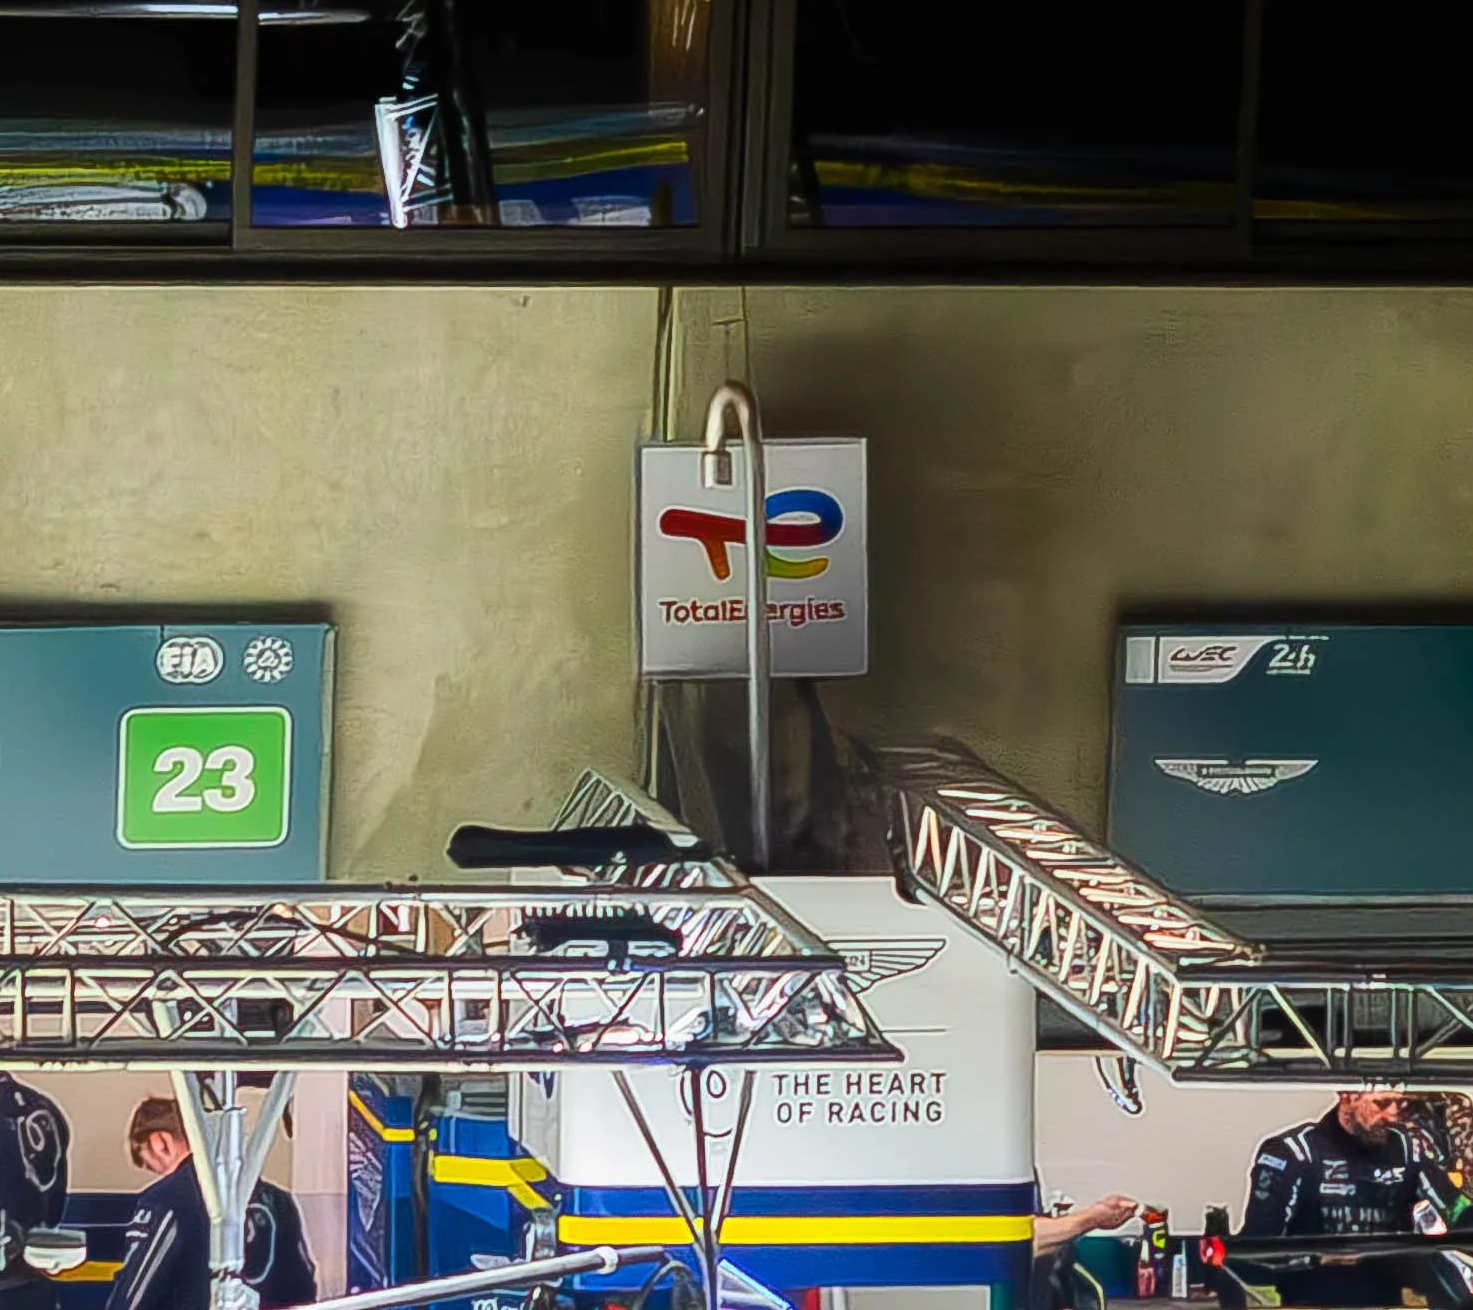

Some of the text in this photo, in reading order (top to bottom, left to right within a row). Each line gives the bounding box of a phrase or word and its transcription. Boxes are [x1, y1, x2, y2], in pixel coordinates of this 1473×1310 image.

[660, 598, 845, 627] TotalEergies
[152, 746, 255, 813] 23
[777, 1073, 945, 1095] THE HEART
[777, 1101, 942, 1123] OF RACING
